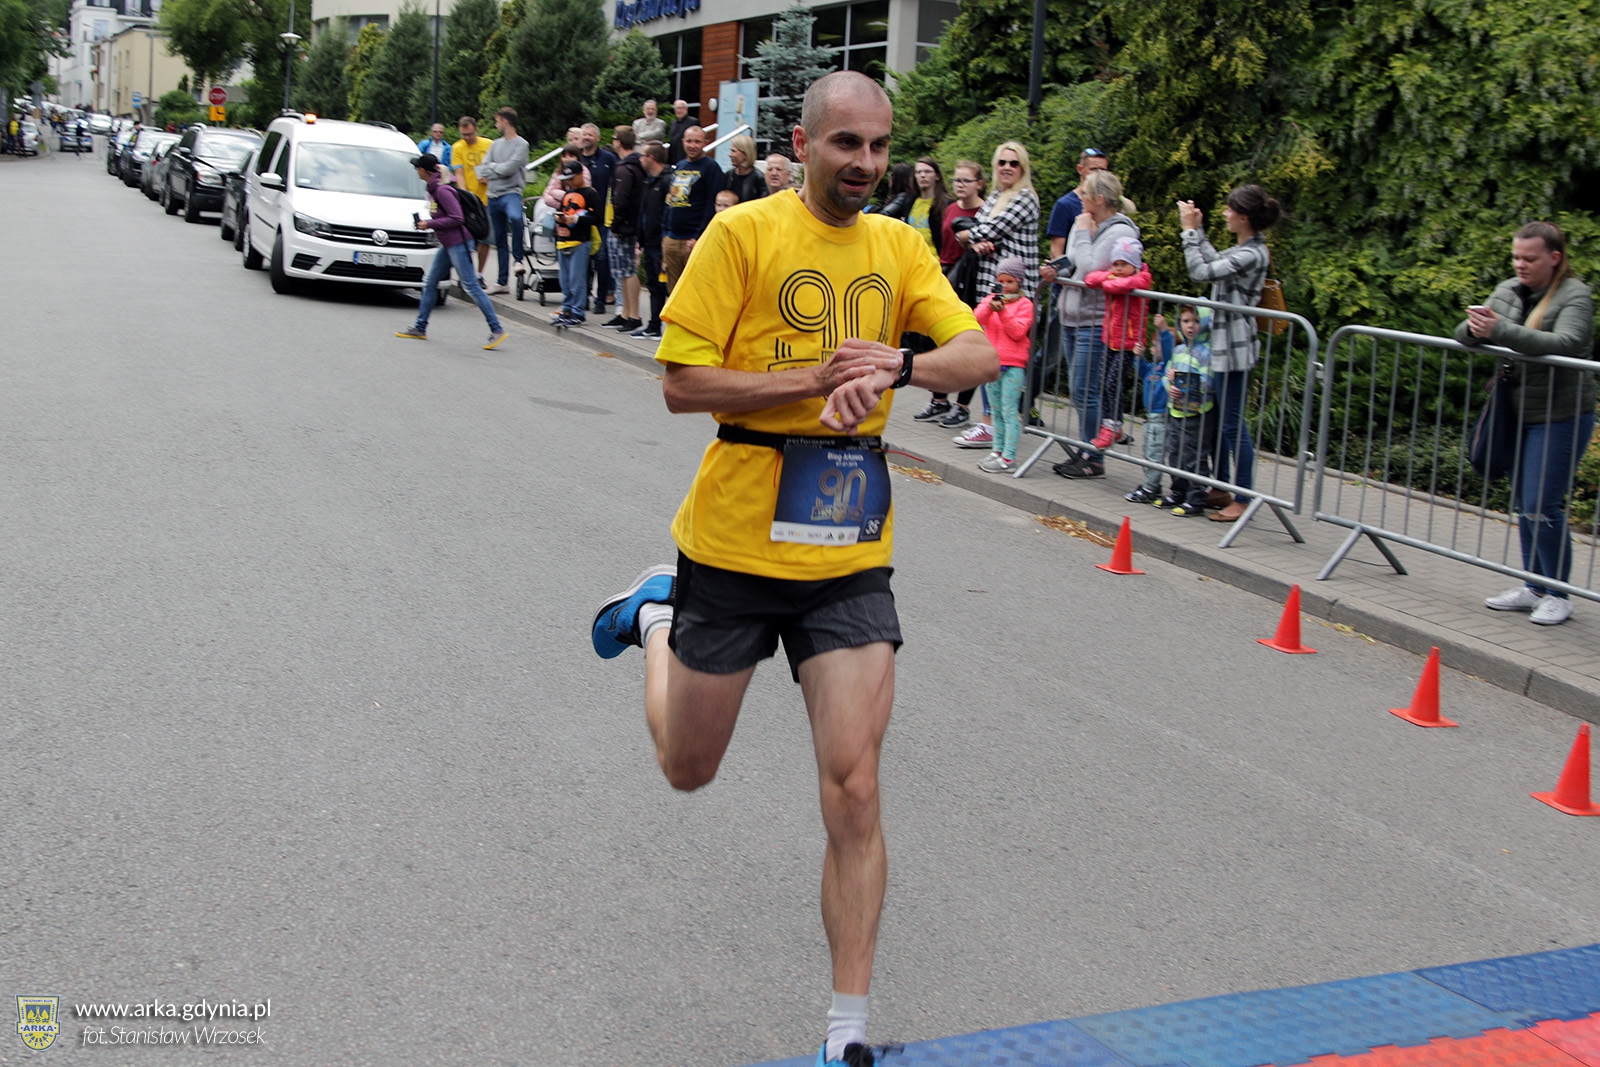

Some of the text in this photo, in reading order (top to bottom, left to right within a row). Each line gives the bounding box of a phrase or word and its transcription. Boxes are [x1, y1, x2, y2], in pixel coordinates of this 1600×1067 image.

[209, 92, 226, 101] STOP
[778, 269, 893, 348] 90
[818, 468, 867, 511] 90
